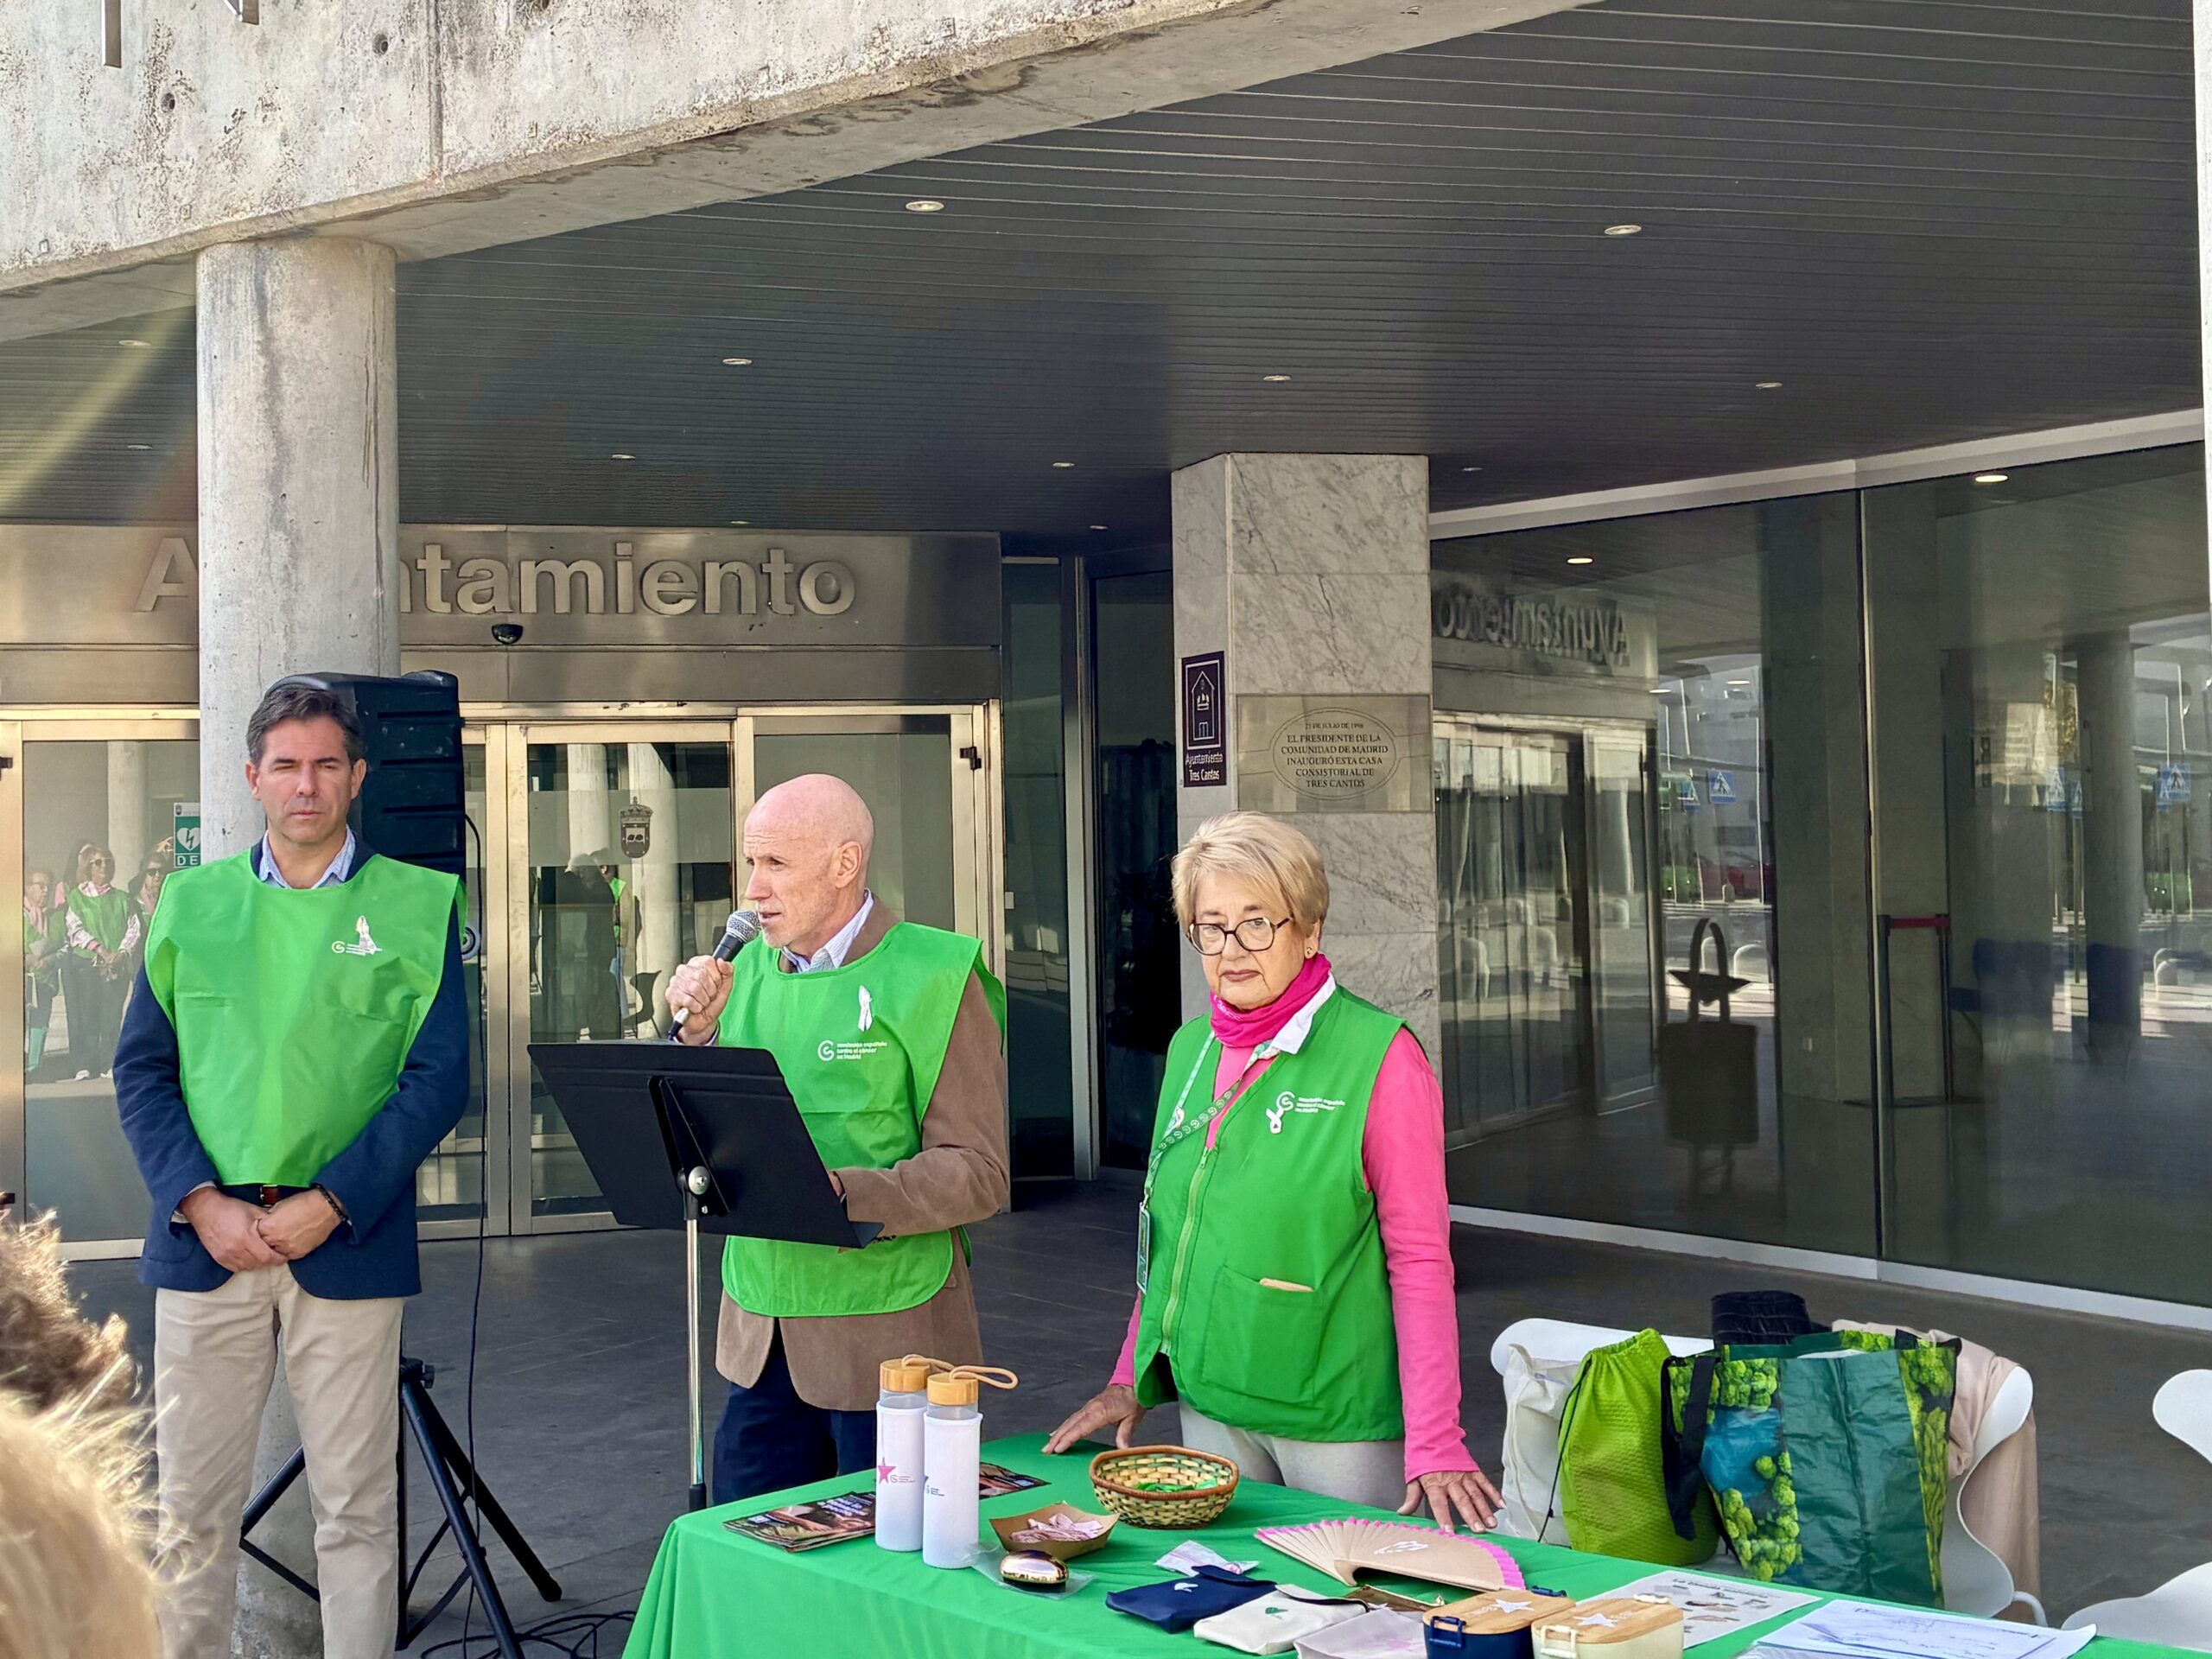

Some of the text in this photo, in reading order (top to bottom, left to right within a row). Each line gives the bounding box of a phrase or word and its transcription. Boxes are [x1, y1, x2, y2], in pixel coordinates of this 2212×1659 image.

[135, 537, 855, 615] Atamiento
[1287, 734, 1299, 743] EL
[1300, 734, 1355, 743] PRESIDENTE
[1281, 746, 1337, 754] COMUNIDAD
[1287, 755, 1334, 766] INAUGURÓ
[1189, 768, 1220, 781] Tres Cantos
[1296, 768, 1361, 777] CONSISTORIAL
[1306, 779, 1365, 788] TRES CANTOS
